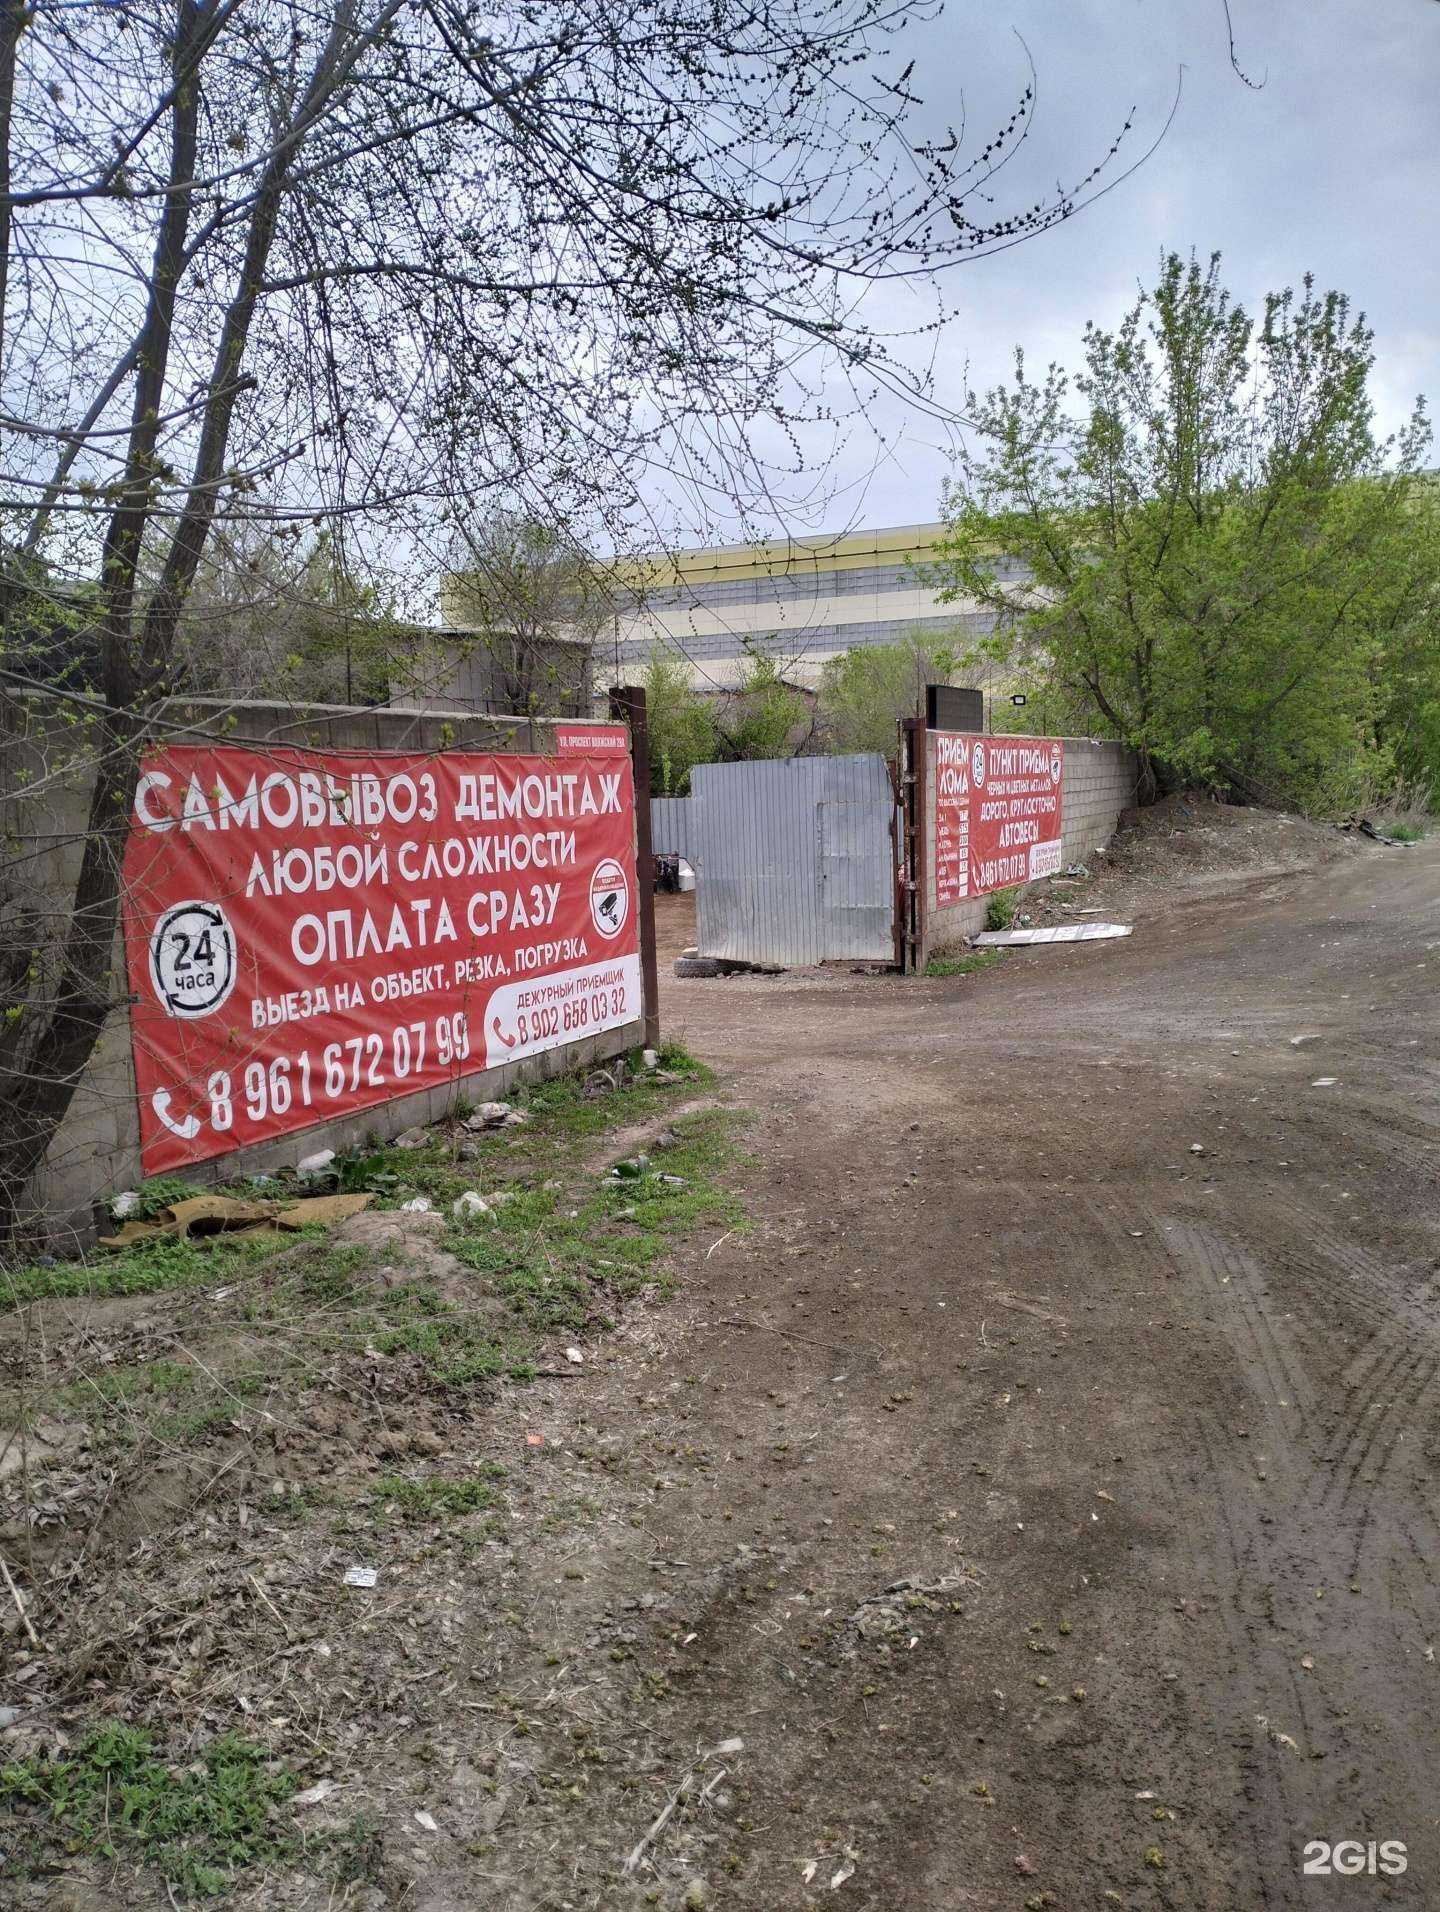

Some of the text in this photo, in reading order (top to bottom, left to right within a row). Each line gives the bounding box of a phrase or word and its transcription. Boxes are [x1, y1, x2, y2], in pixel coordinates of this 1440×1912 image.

[939, 768, 969, 795] ЛОМА
[989, 749, 1017, 776] ПУНКТ
[134, 771, 622, 833] САМОВЫВОЗ ДЕМОНТАЖ
[1010, 796, 1056, 818] КРУГЛОСУТОЧНО
[999, 821, 1040, 848] АВТОВЕСЫ
[245, 831, 576, 898] ЛЮБОЙ СЛОЖНОСТИ
[291, 882, 562, 966] ОПЛАТА СРАЗУ
[171, 929, 216, 971] 24
[175, 971, 215, 991] часа
[251, 937, 588, 1029] ВЫЕЗД НА ОБЪЕКТ, РЕЗКА, ПОГРУЗКА
[516, 968, 625, 1010] ДЕЖУРНЫЙ ПРИЕМЩИК
[517, 986, 627, 1046] 8 902 658 03 32
[207, 1011, 470, 1131] 8 961 672 07 99
